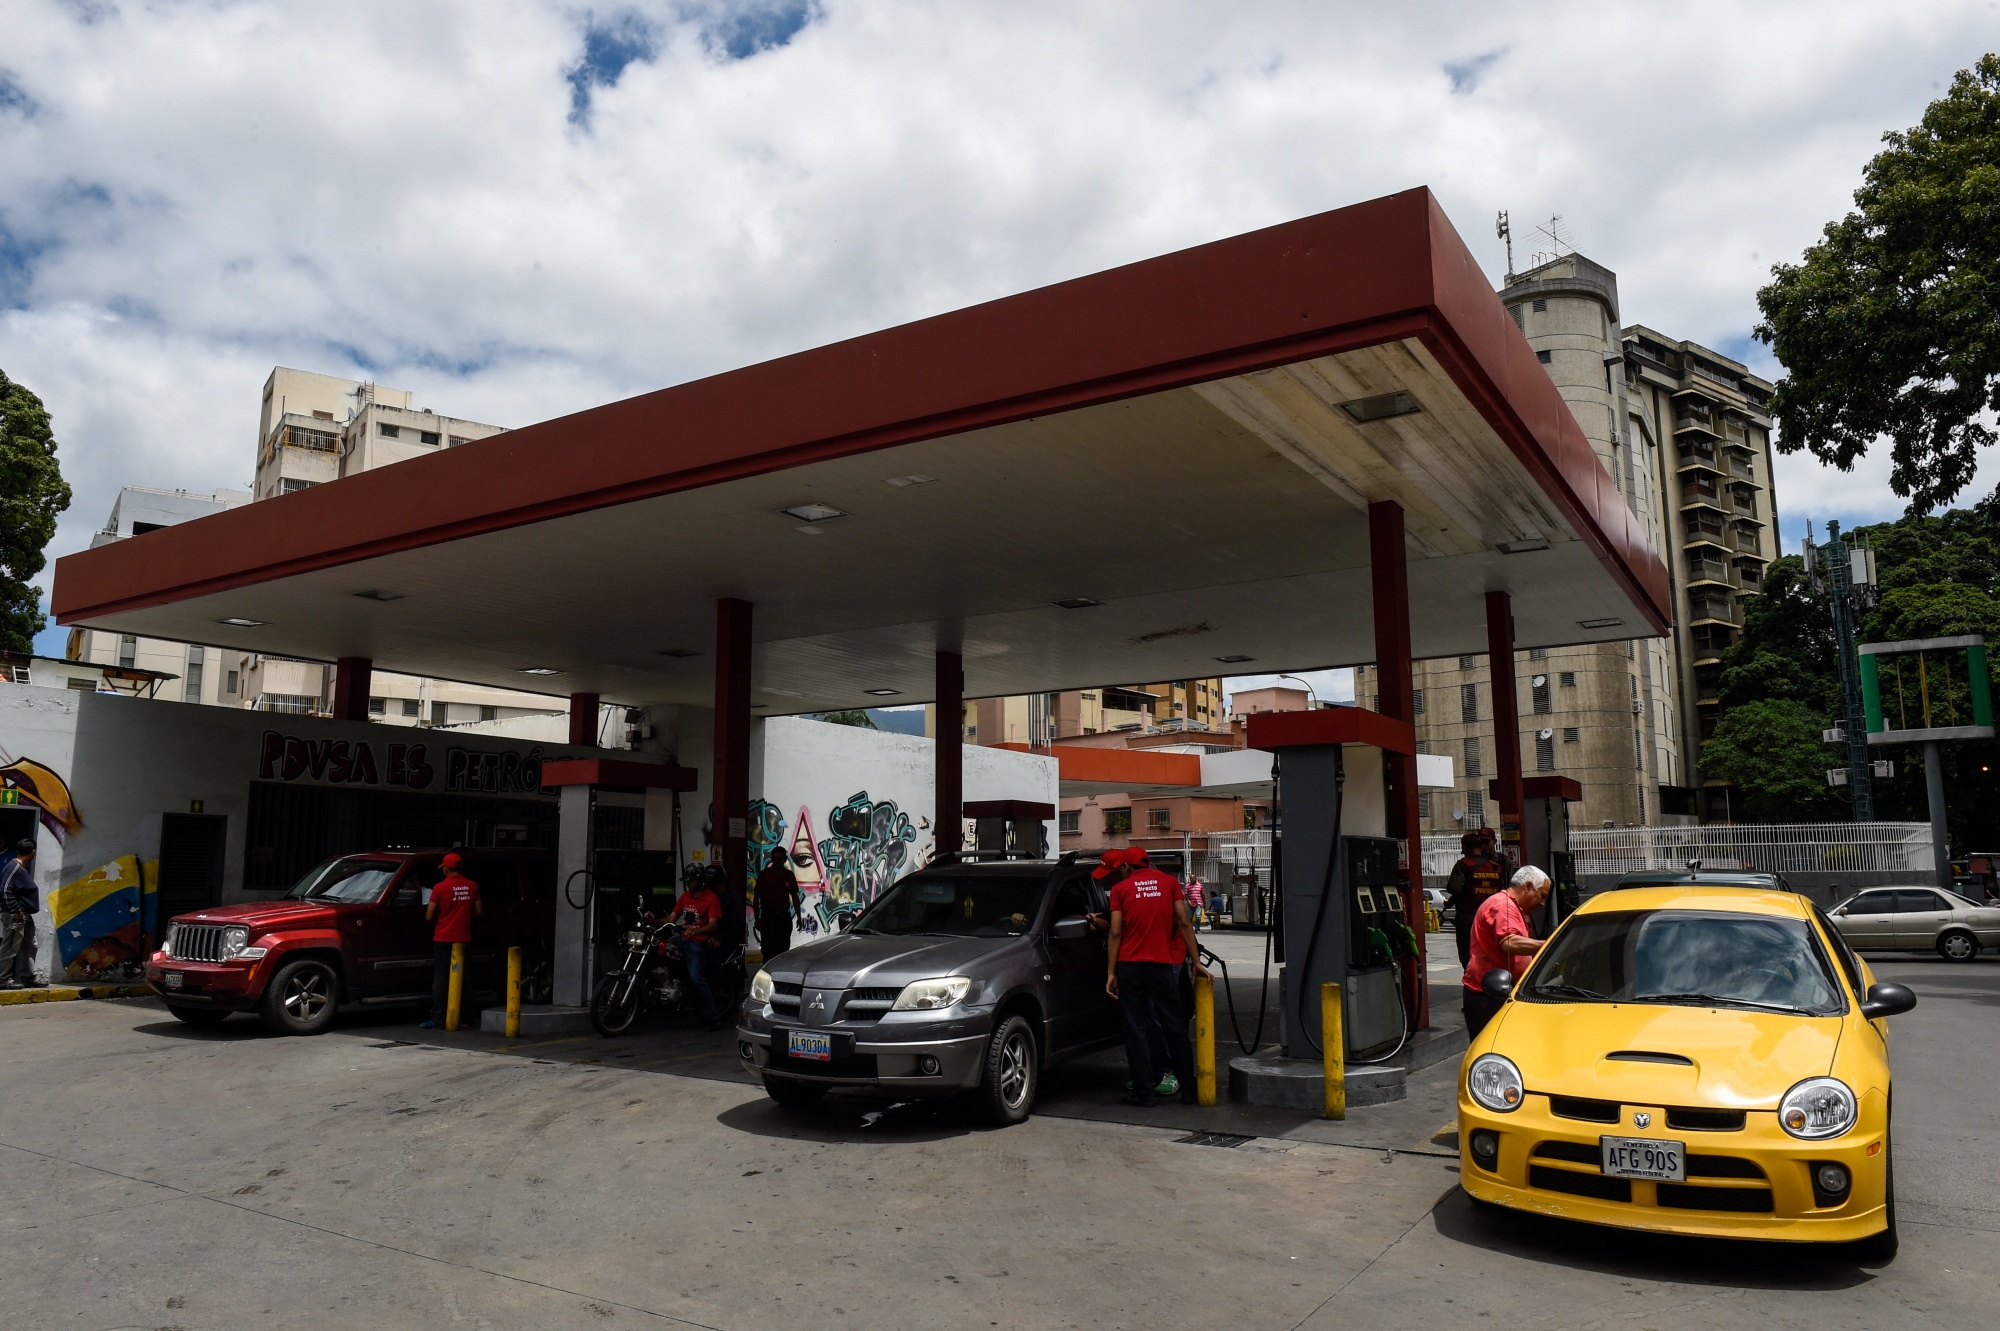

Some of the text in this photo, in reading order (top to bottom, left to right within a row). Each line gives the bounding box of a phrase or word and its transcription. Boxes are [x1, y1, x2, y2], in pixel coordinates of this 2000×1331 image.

[259, 730, 586, 796] PDVSA ES PETRÓ
[791, 1037, 828, 1055] AL903DA
[1609, 1147, 1677, 1171] AFG 90S
[1620, 1168, 1665, 1178] DISTRITO FEDERAL
